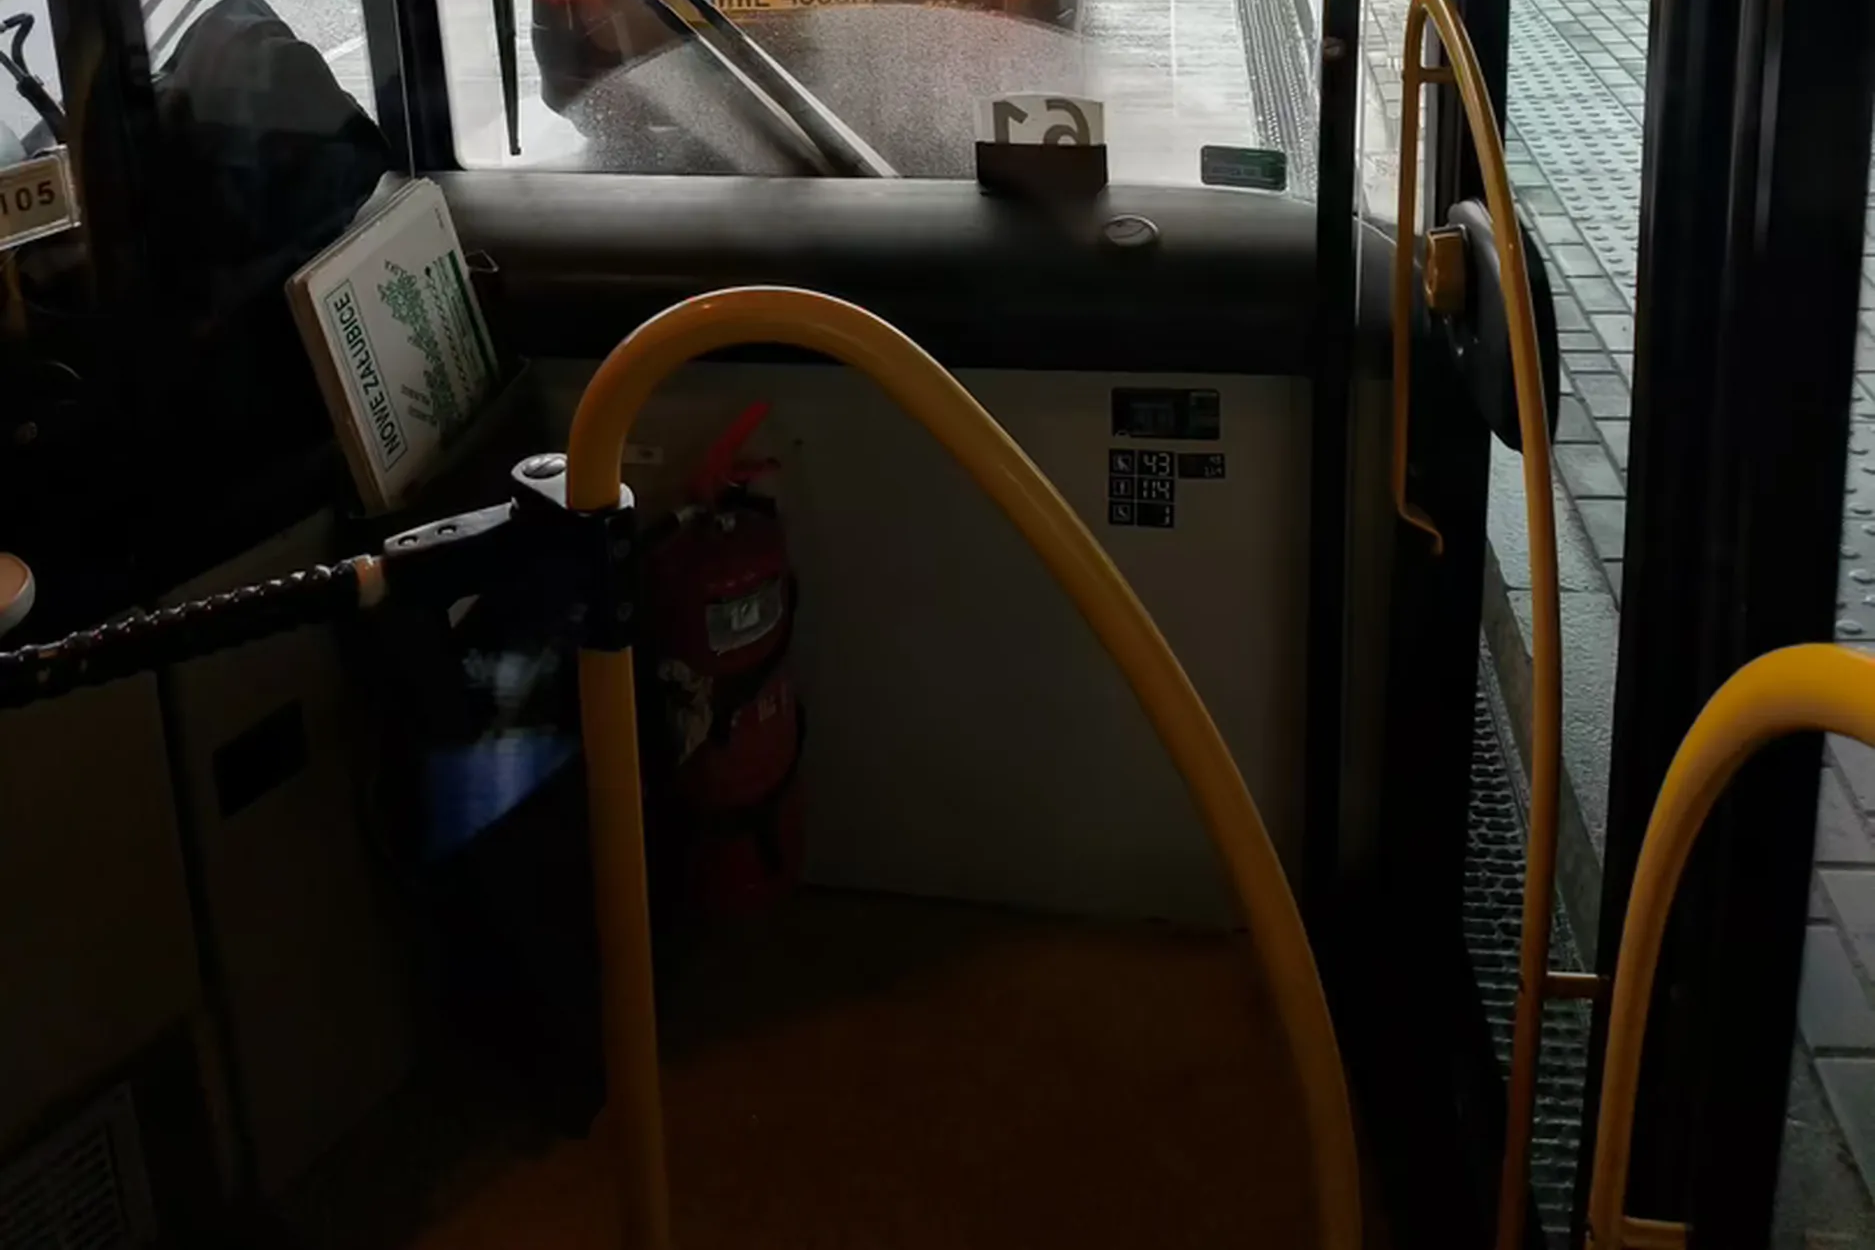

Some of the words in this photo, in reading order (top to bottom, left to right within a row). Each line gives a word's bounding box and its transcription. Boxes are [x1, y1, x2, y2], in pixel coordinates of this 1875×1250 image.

[333, 292, 379, 395] ZAŁUBICE
[369, 391, 401, 455] NOWE
[1143, 452, 1171, 476] 43
